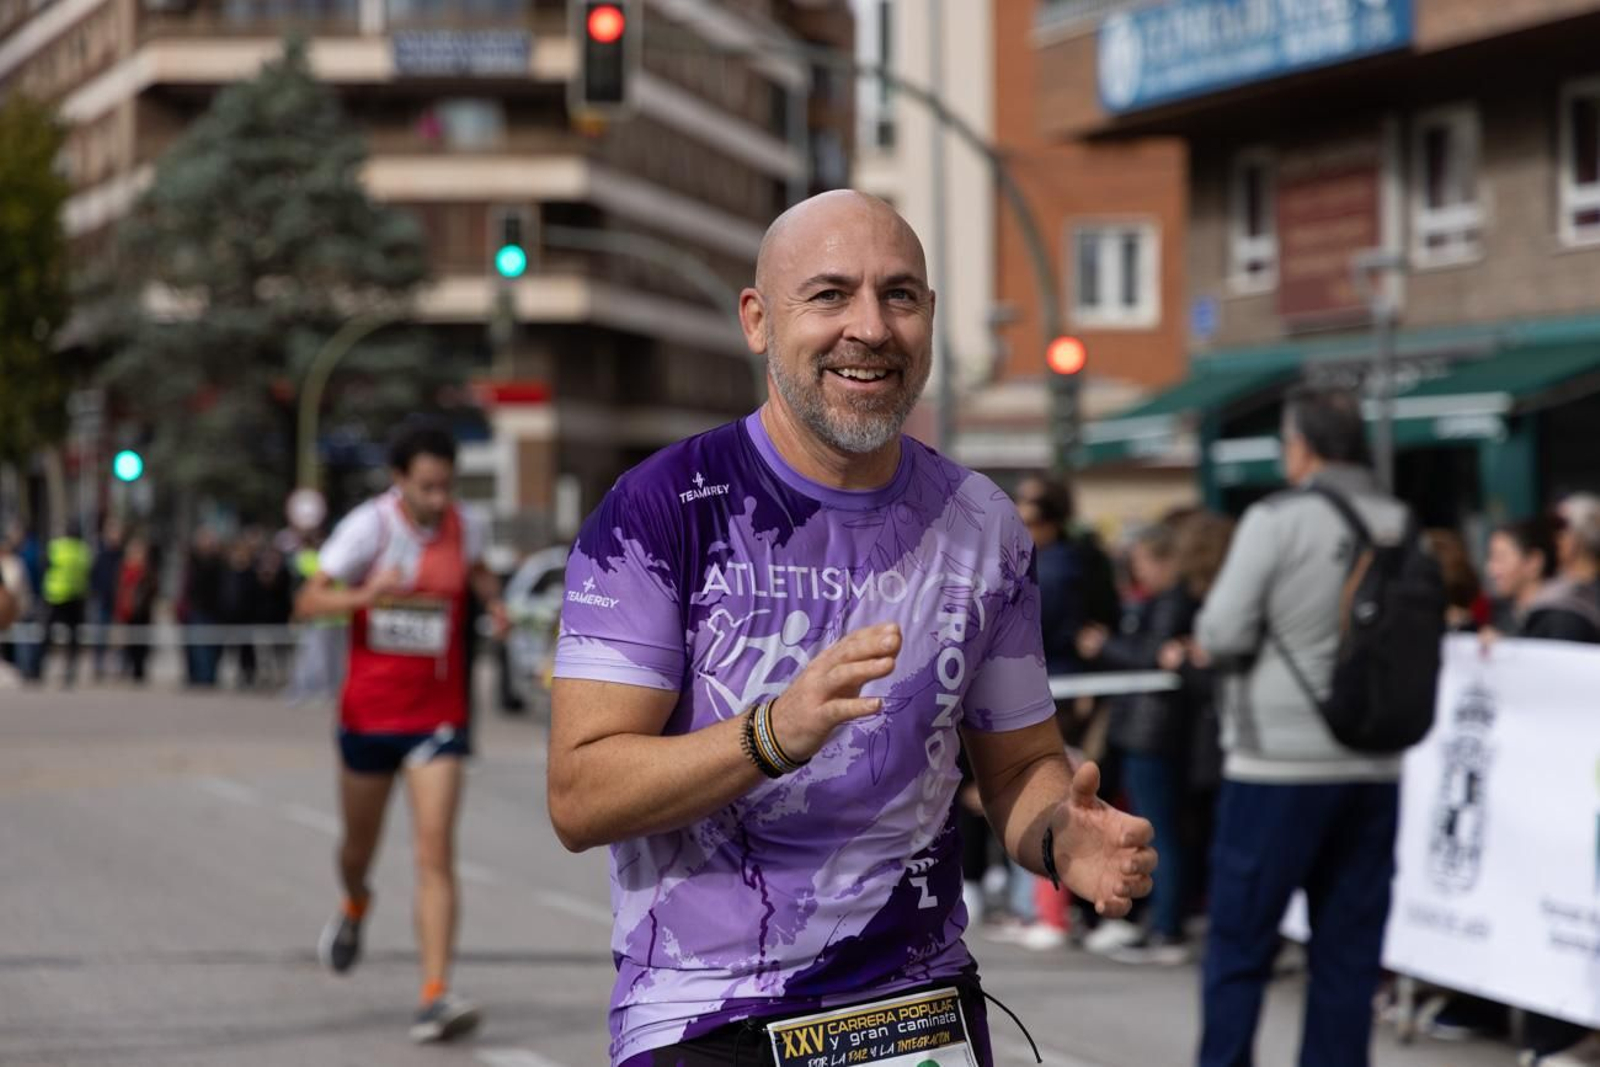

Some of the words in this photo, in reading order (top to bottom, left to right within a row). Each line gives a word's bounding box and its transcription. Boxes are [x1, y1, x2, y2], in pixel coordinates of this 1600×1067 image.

[701, 561, 908, 604] ATLETISMO
[780, 1024, 824, 1060] XXV
[826, 1011, 897, 1035] CARRERA
[899, 999, 955, 1021] POPULAR
[829, 1035, 839, 1051] y
[849, 1026, 889, 1046] gran
[897, 1012, 957, 1033] caminata
[830, 1052, 846, 1067] LA
[879, 1042, 895, 1057] LA
